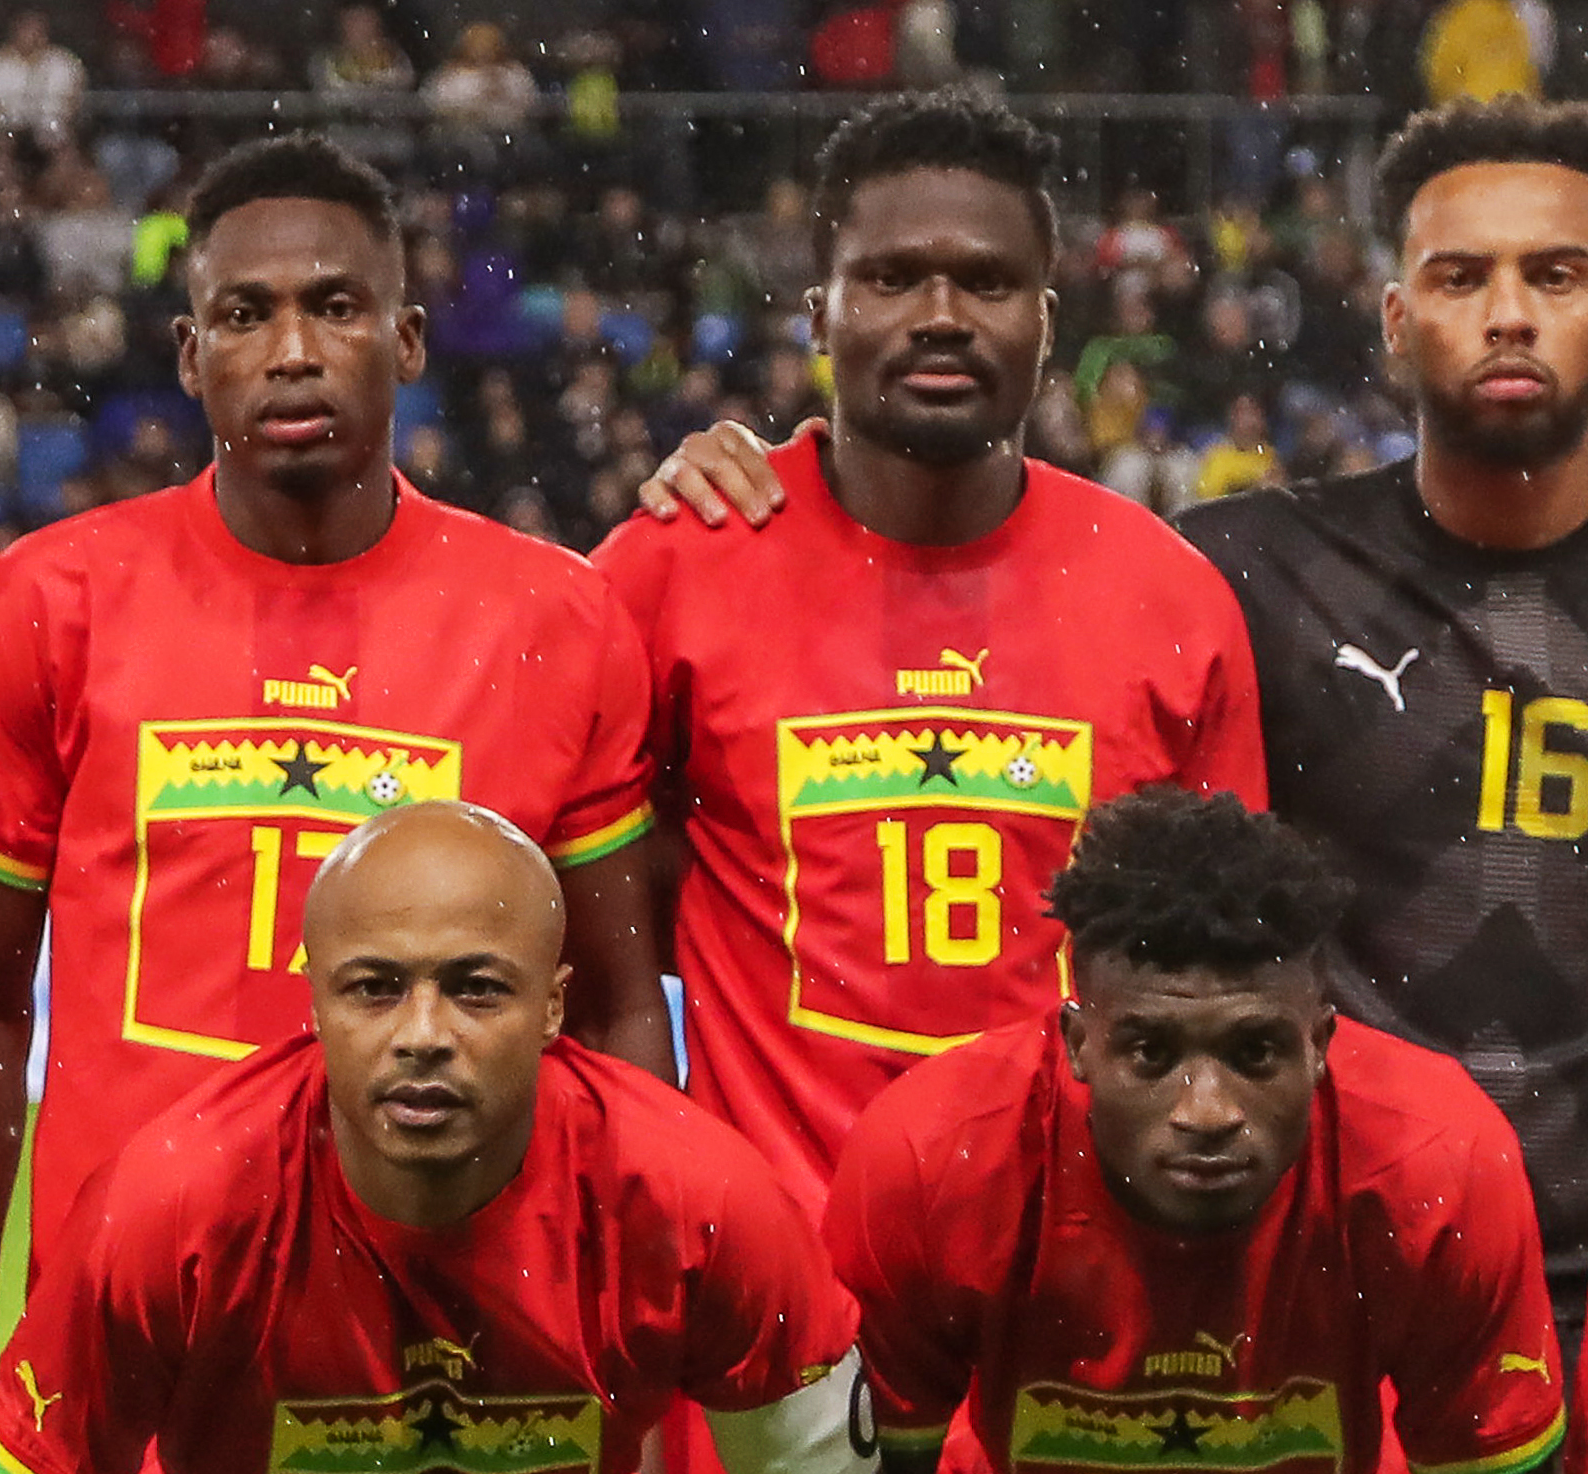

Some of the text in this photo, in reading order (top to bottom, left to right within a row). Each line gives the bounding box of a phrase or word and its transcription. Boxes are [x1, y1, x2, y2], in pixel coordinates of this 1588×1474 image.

[264, 680, 337, 708] PUMA
[897, 670, 972, 696] PUMA
[876, 821, 1003, 967] 18
